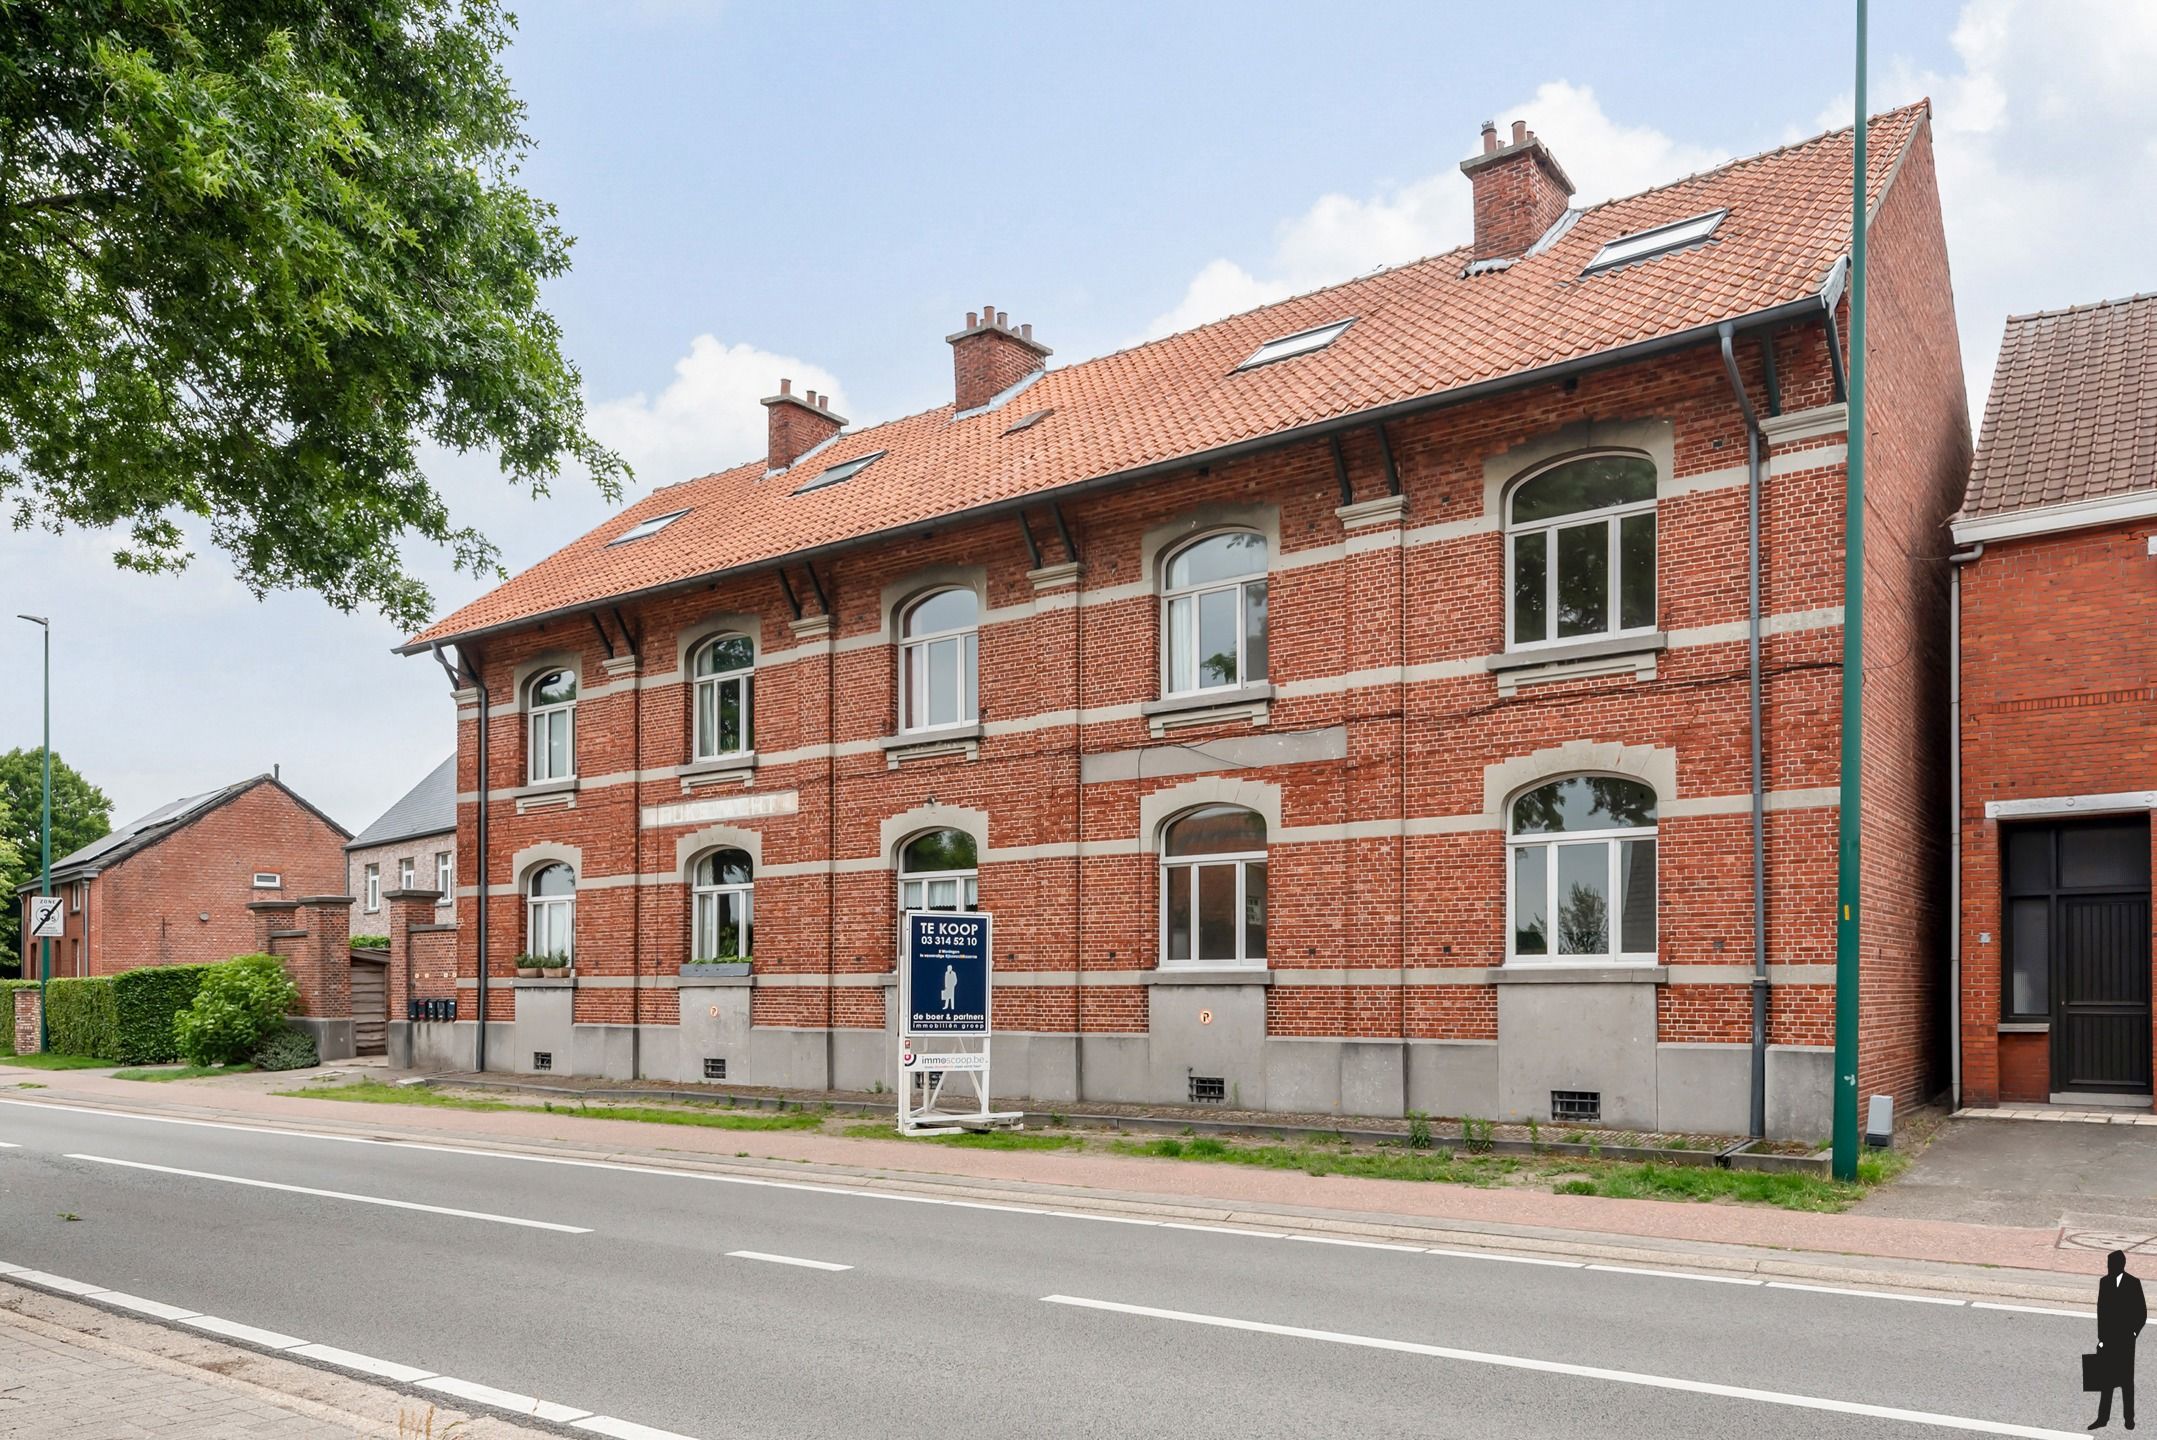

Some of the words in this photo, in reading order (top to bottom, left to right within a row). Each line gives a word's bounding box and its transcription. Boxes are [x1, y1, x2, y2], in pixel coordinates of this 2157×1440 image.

[920, 922, 934, 934] TE
[939, 923, 979, 935] KOOP
[921, 936, 933, 945] 03
[934, 936, 951, 945] 314
[953, 937, 965, 945] 52
[967, 937, 978, 946] 10
[953, 1013, 984, 1022] partners
[921, 1056, 984, 1065] immoscoop.be
